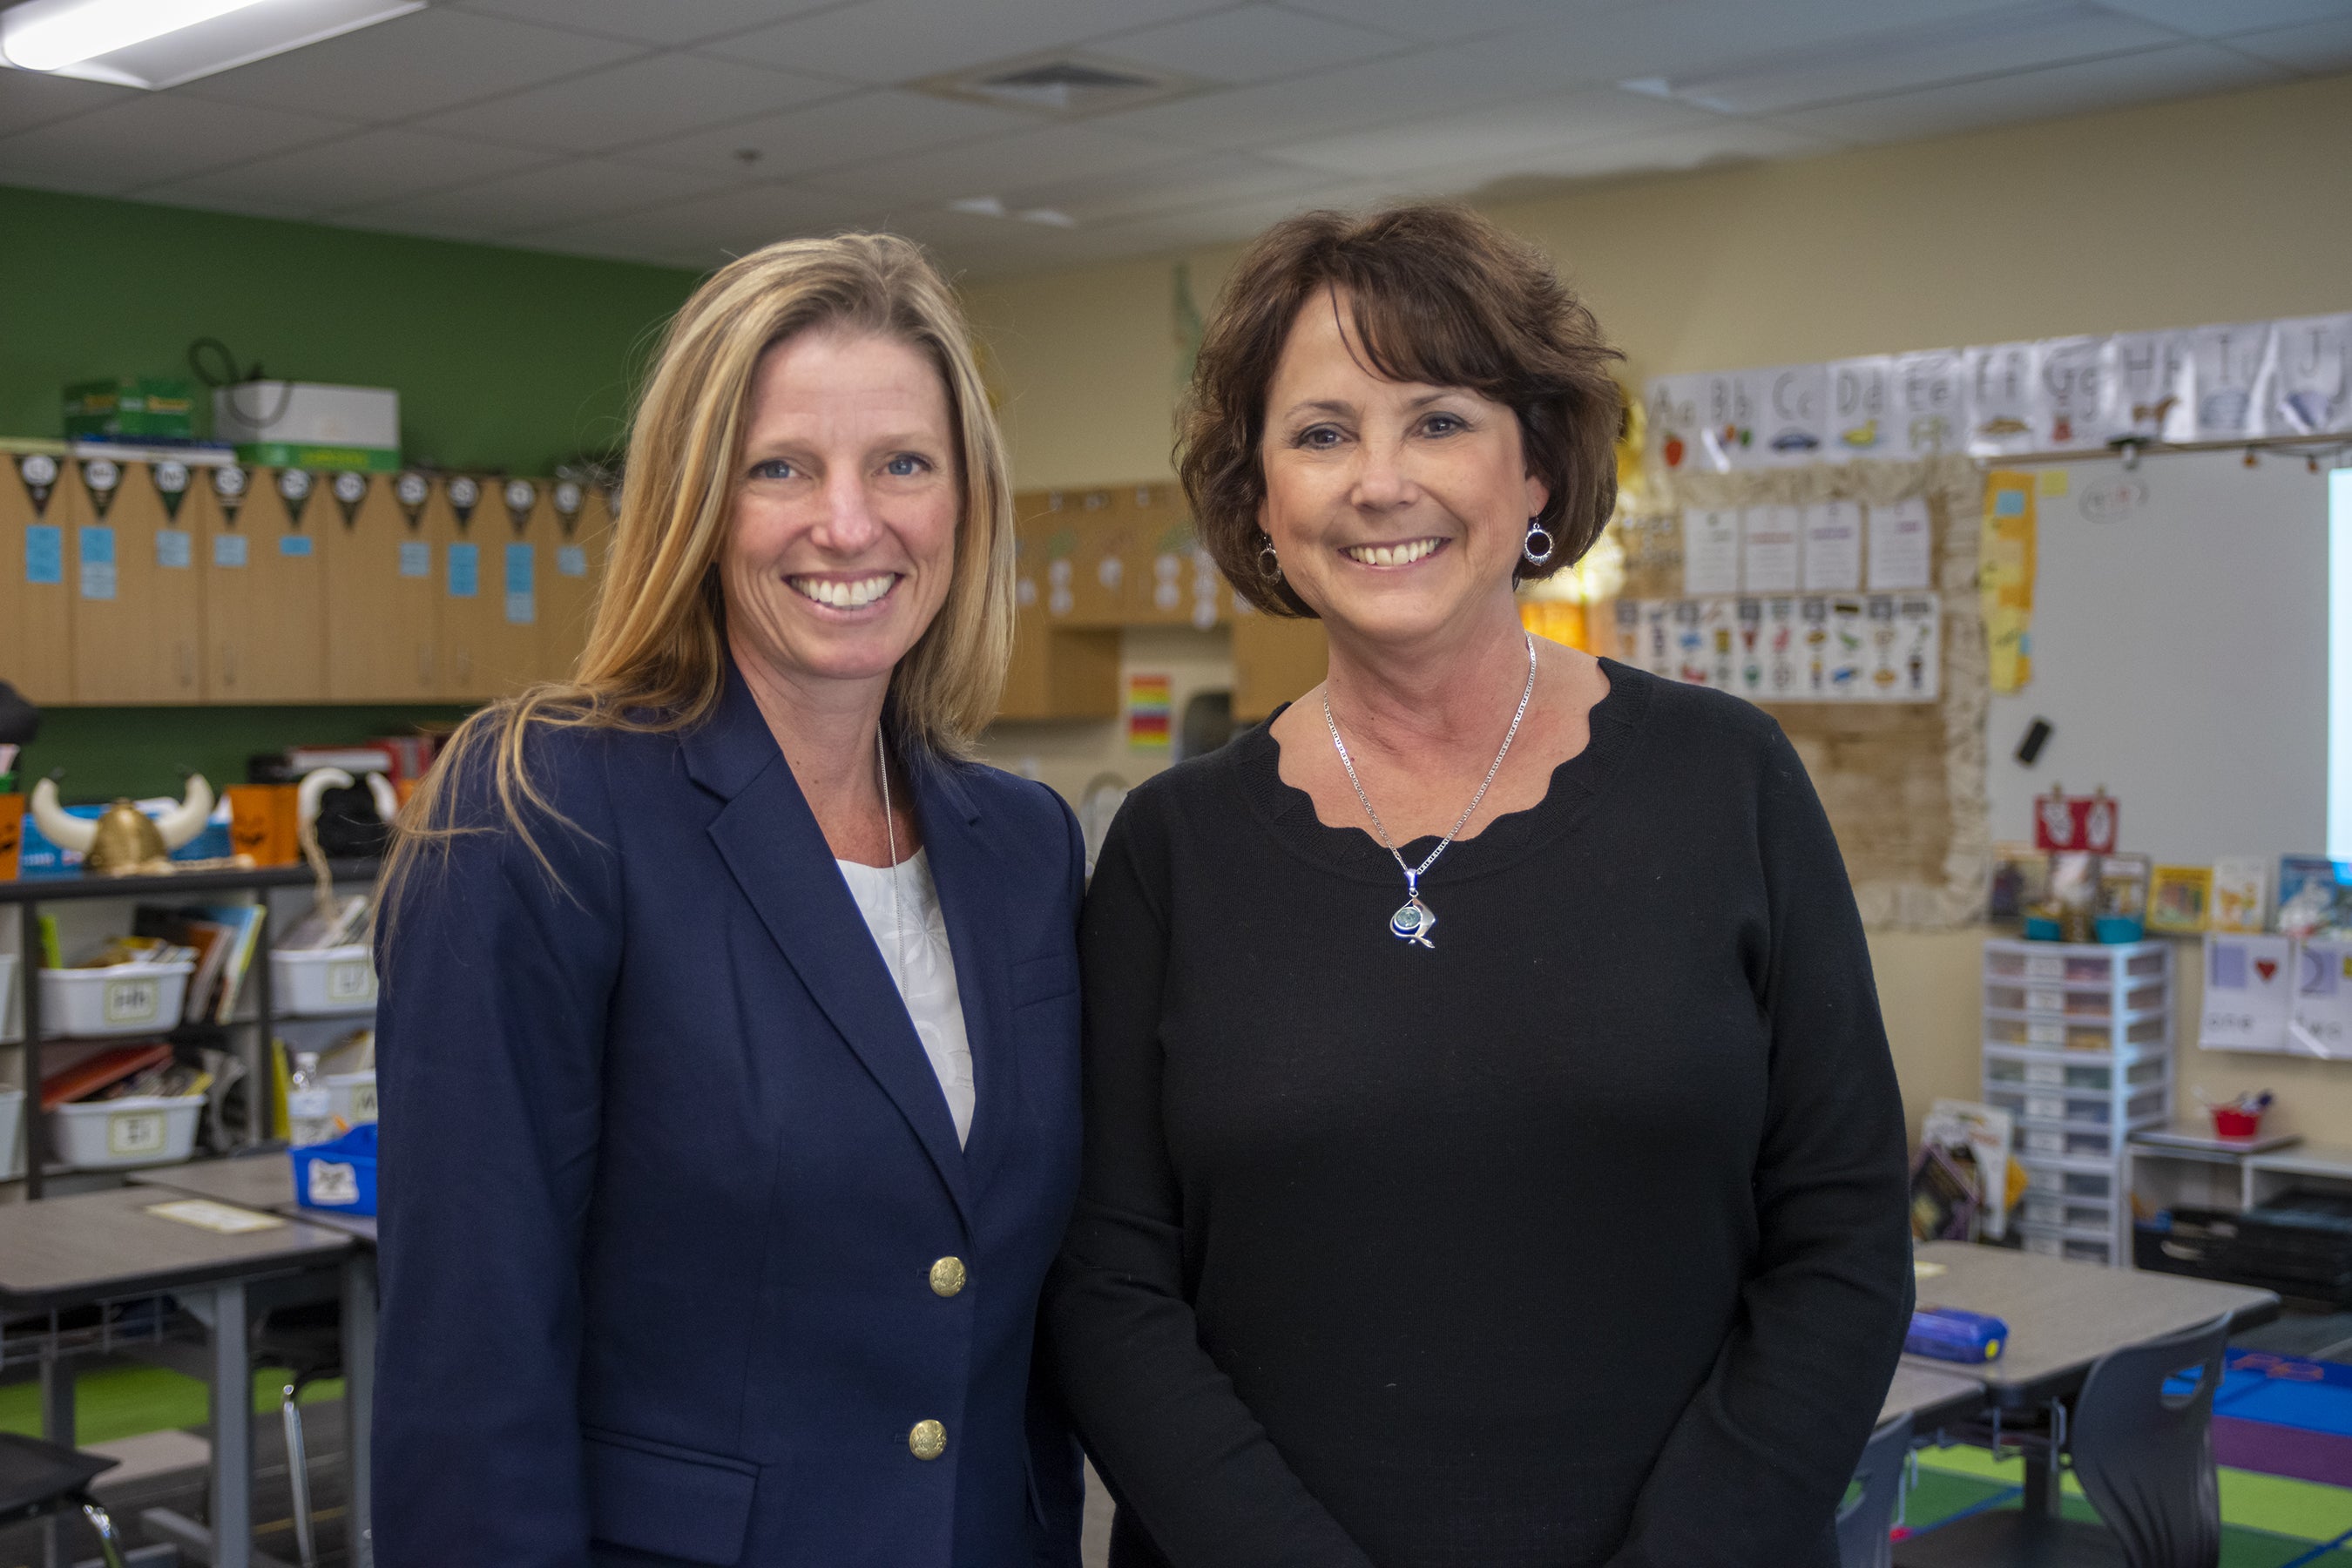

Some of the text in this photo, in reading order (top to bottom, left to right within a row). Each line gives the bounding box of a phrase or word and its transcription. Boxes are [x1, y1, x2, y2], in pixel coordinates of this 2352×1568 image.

[1710, 376, 1754, 423] Bb
[1771, 370, 1815, 420] Cc
[1835, 368, 1884, 418] Dd
[1906, 367, 1950, 412] Ee
